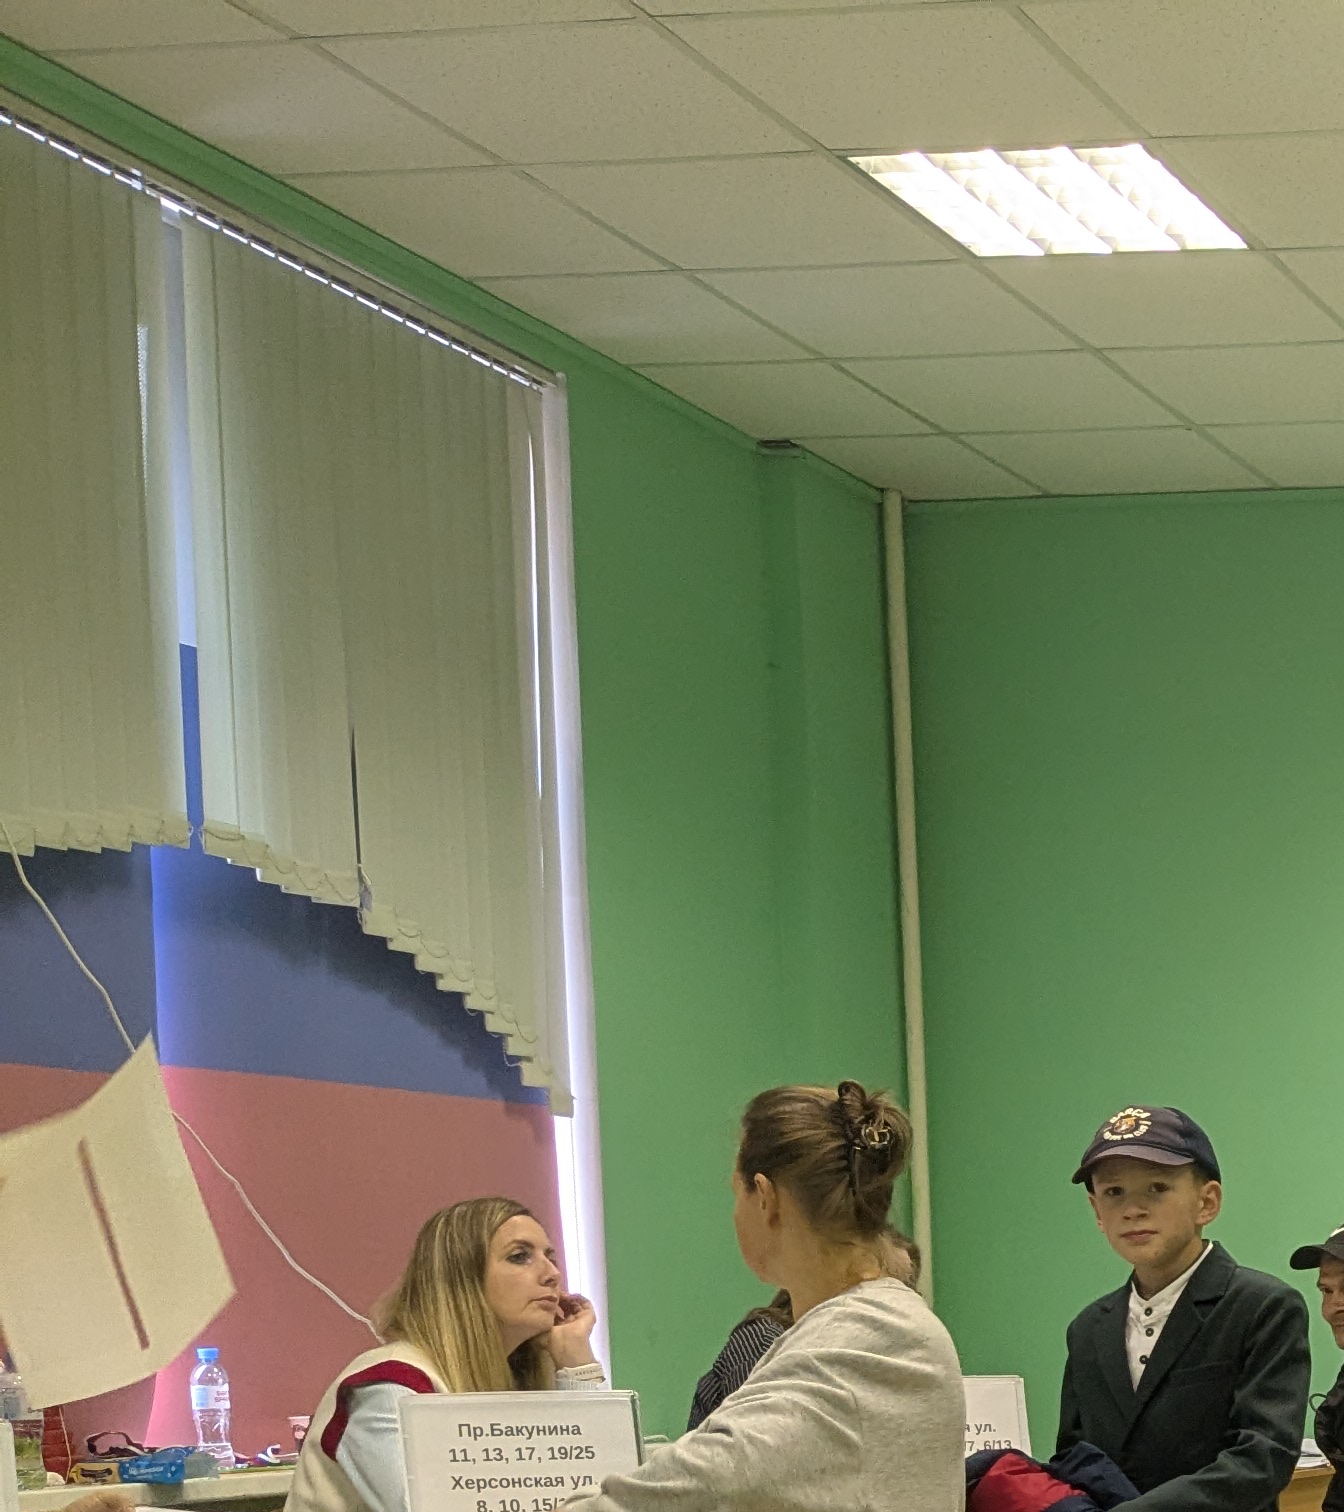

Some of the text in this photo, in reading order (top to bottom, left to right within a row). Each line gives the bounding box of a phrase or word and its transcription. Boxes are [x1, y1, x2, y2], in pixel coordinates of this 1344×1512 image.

[458, 1423, 582, 1441] Пр.Бакунина
[449, 1445, 595, 1465] 11, 13, 17, 19/25
[450, 1475, 565, 1494] Херсонская
